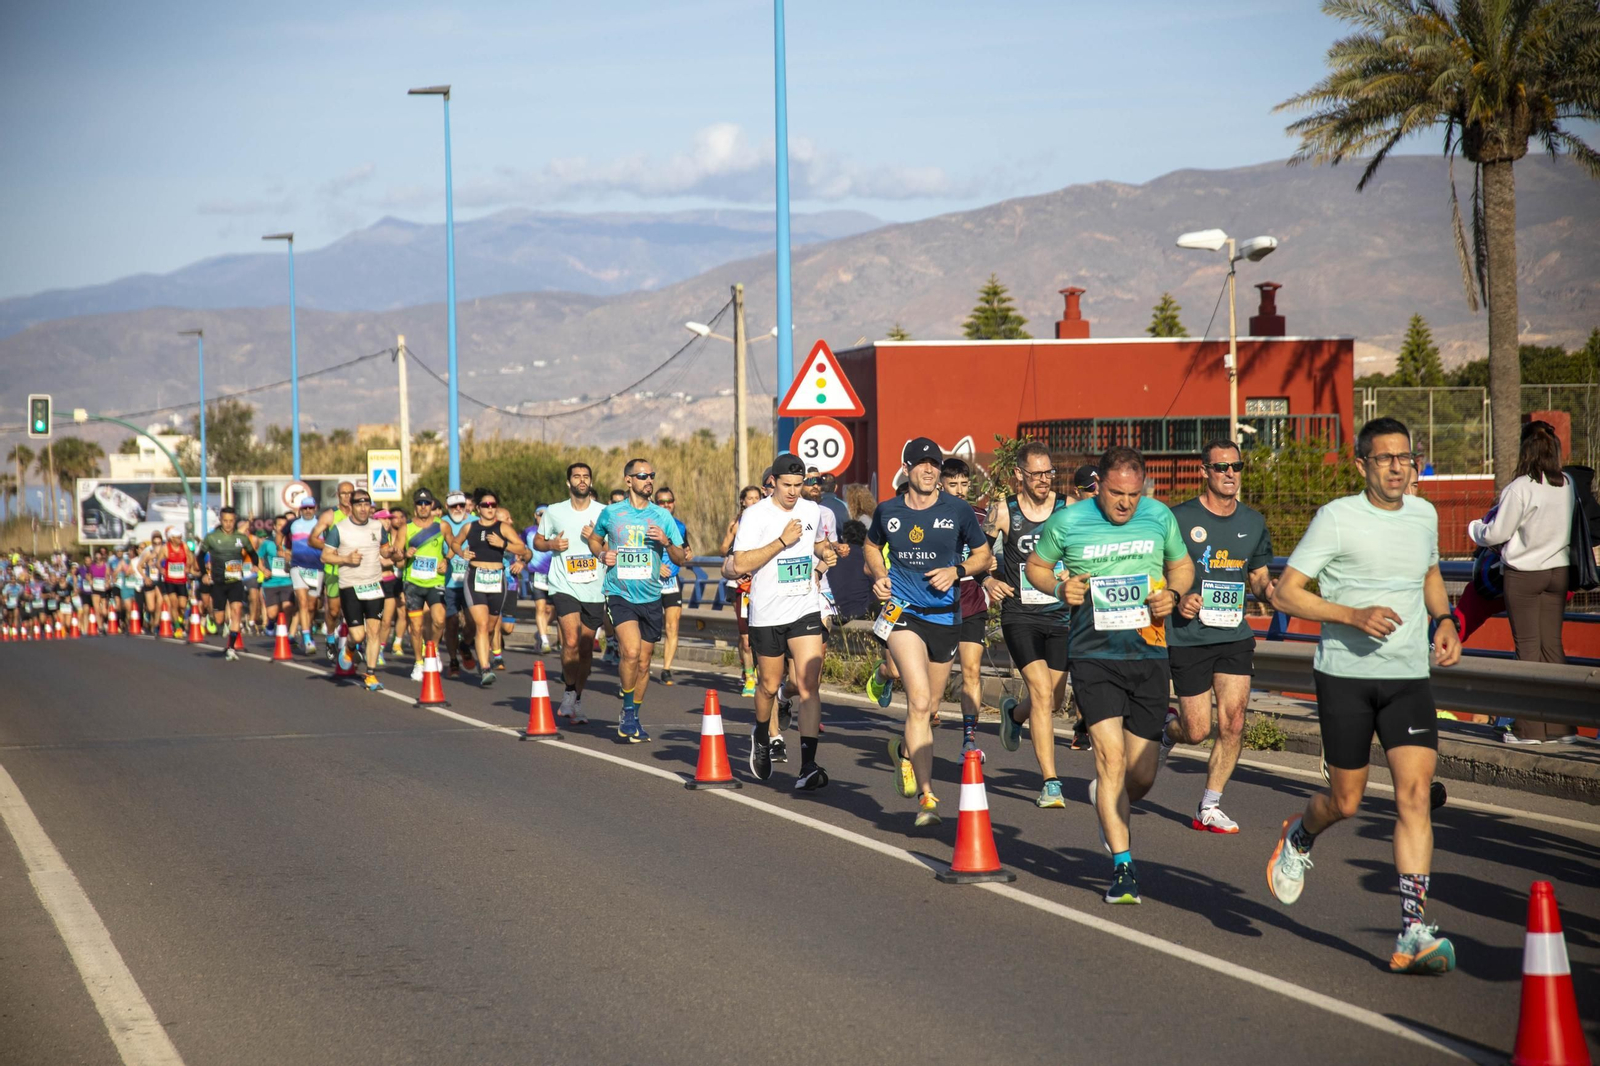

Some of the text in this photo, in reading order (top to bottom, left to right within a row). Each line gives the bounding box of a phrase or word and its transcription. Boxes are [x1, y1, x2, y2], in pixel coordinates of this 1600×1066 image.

[804, 438, 839, 458] 30
[898, 551, 936, 559] REY SILO
[1082, 540, 1154, 559] SUPERA
[1215, 550, 1229, 559] GO
[570, 558, 595, 568] 1483
[621, 553, 648, 563] 1013
[414, 560, 435, 568] 1218
[787, 563, 808, 576] 117
[1106, 586, 1140, 602] 690
[1212, 591, 1238, 604] 888
